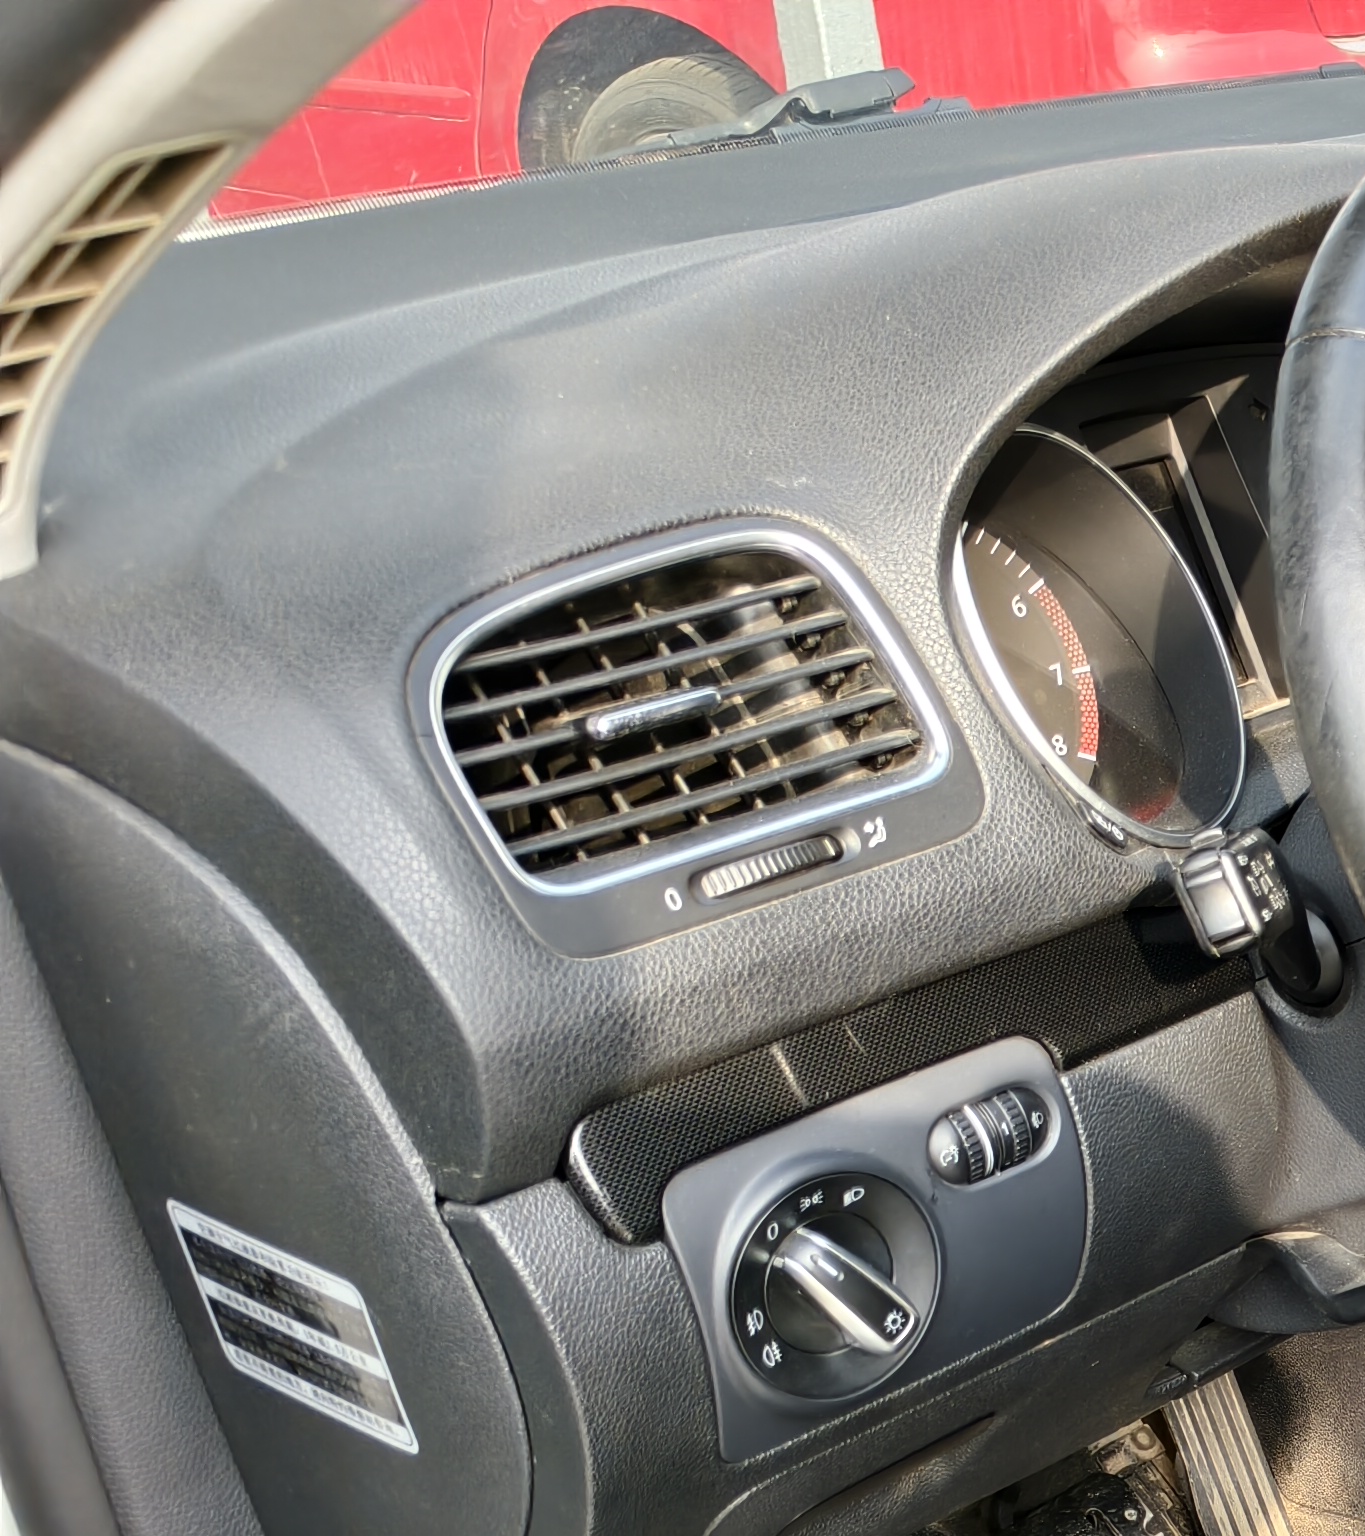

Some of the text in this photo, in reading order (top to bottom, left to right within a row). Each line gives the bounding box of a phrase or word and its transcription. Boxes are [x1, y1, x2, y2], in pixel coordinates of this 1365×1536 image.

[1011, 594, 1027, 617] 6
[1048, 662, 1063, 686] 7
[1051, 734, 1068, 756] 8
[664, 886, 682, 911] 0
[767, 1221, 779, 1241] 0
